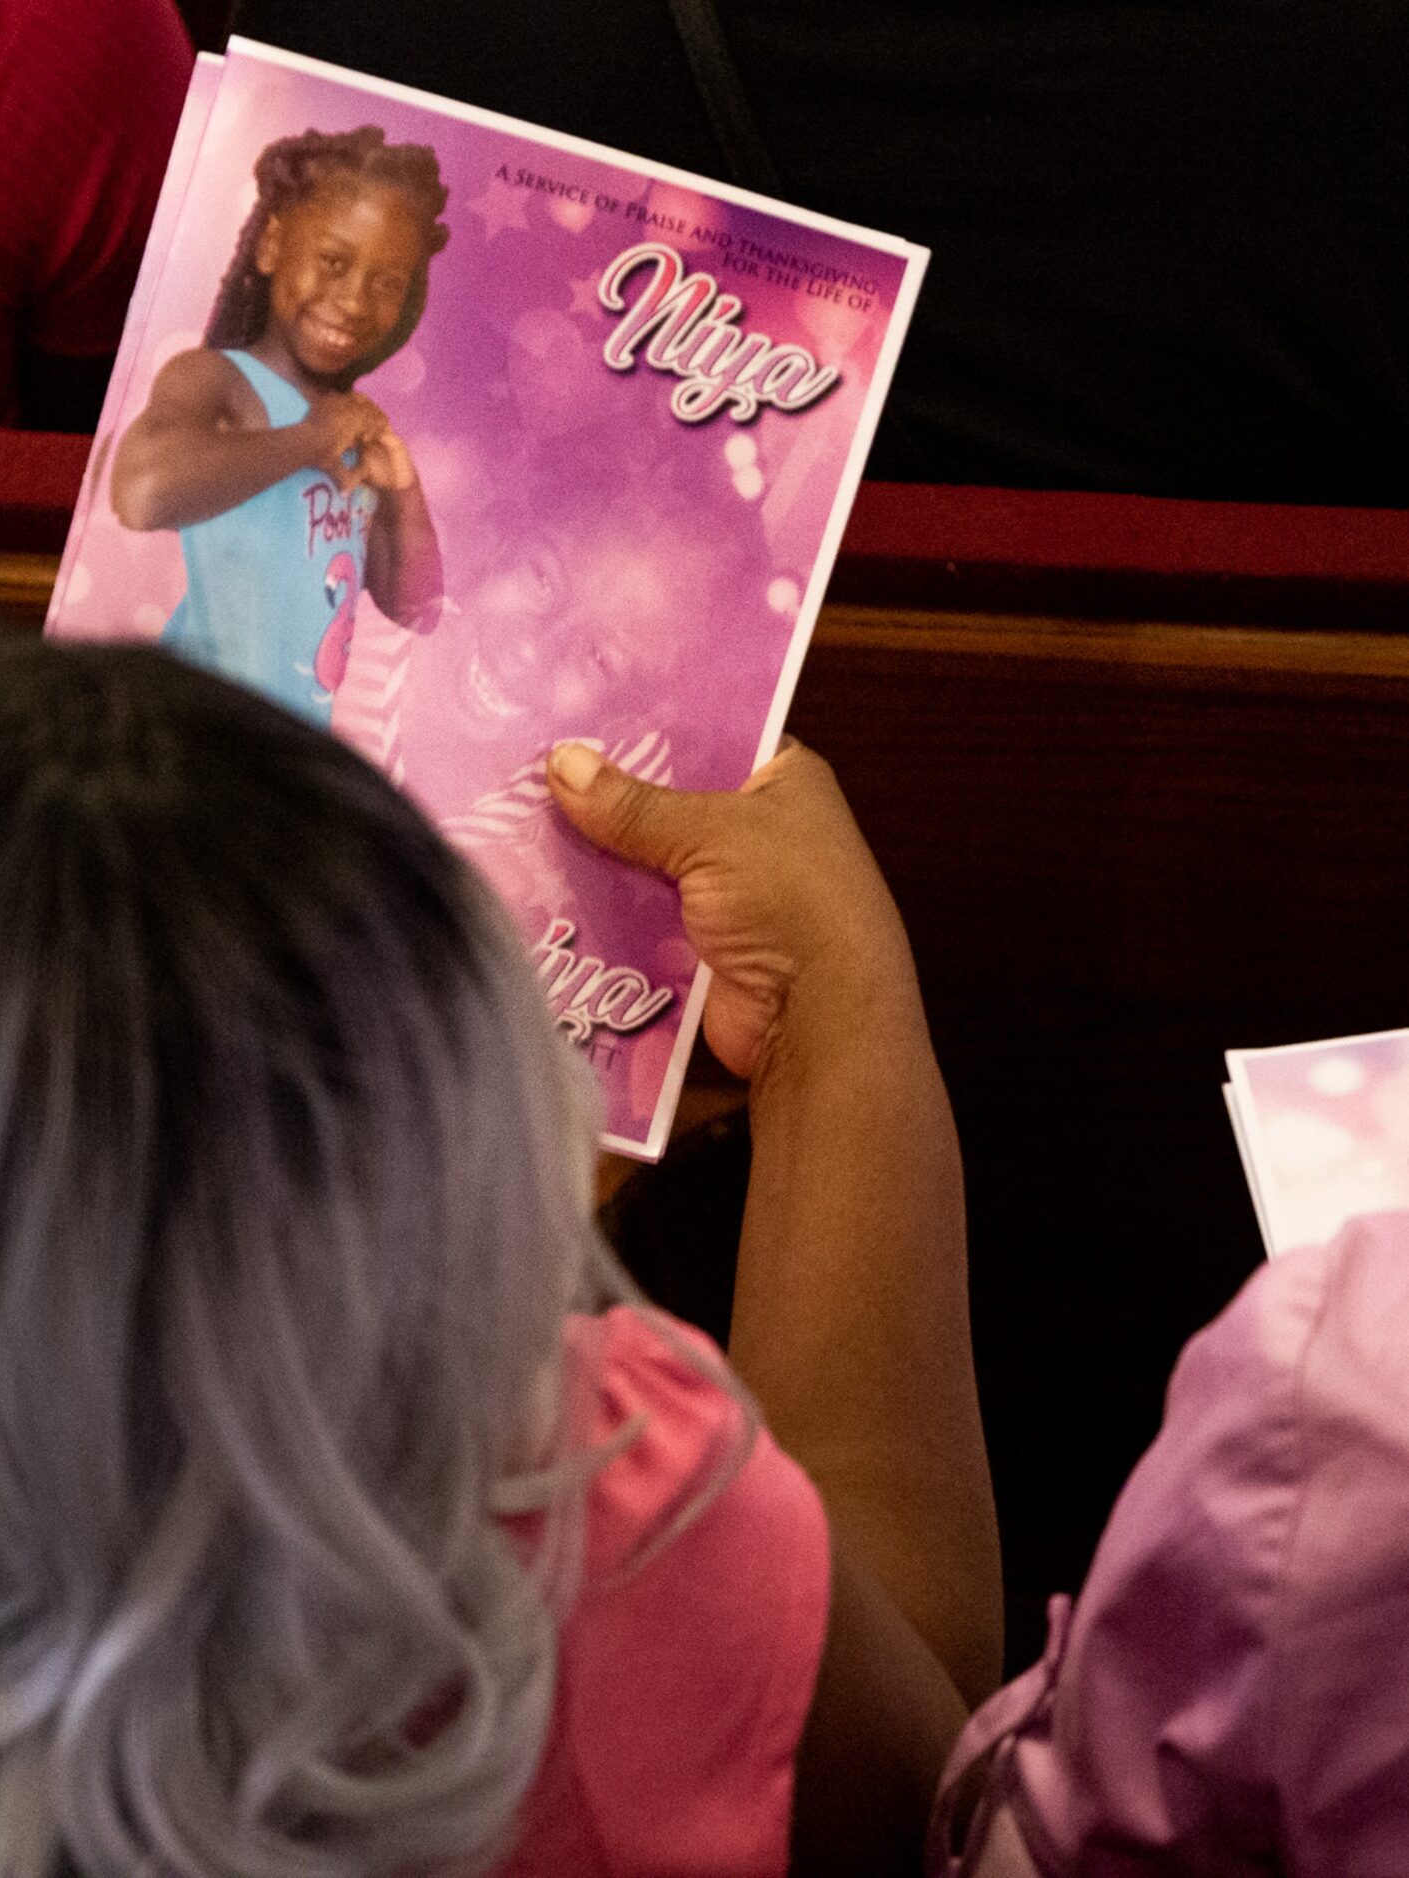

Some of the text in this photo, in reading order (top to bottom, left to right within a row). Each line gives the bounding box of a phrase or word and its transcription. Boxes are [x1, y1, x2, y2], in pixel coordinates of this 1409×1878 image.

[494, 163, 880, 295] A SERVICE OF PRAISE AND THANKSGIVING
[722, 251, 874, 313] FOR THE LIFE OF
[598, 241, 839, 423] Niya
